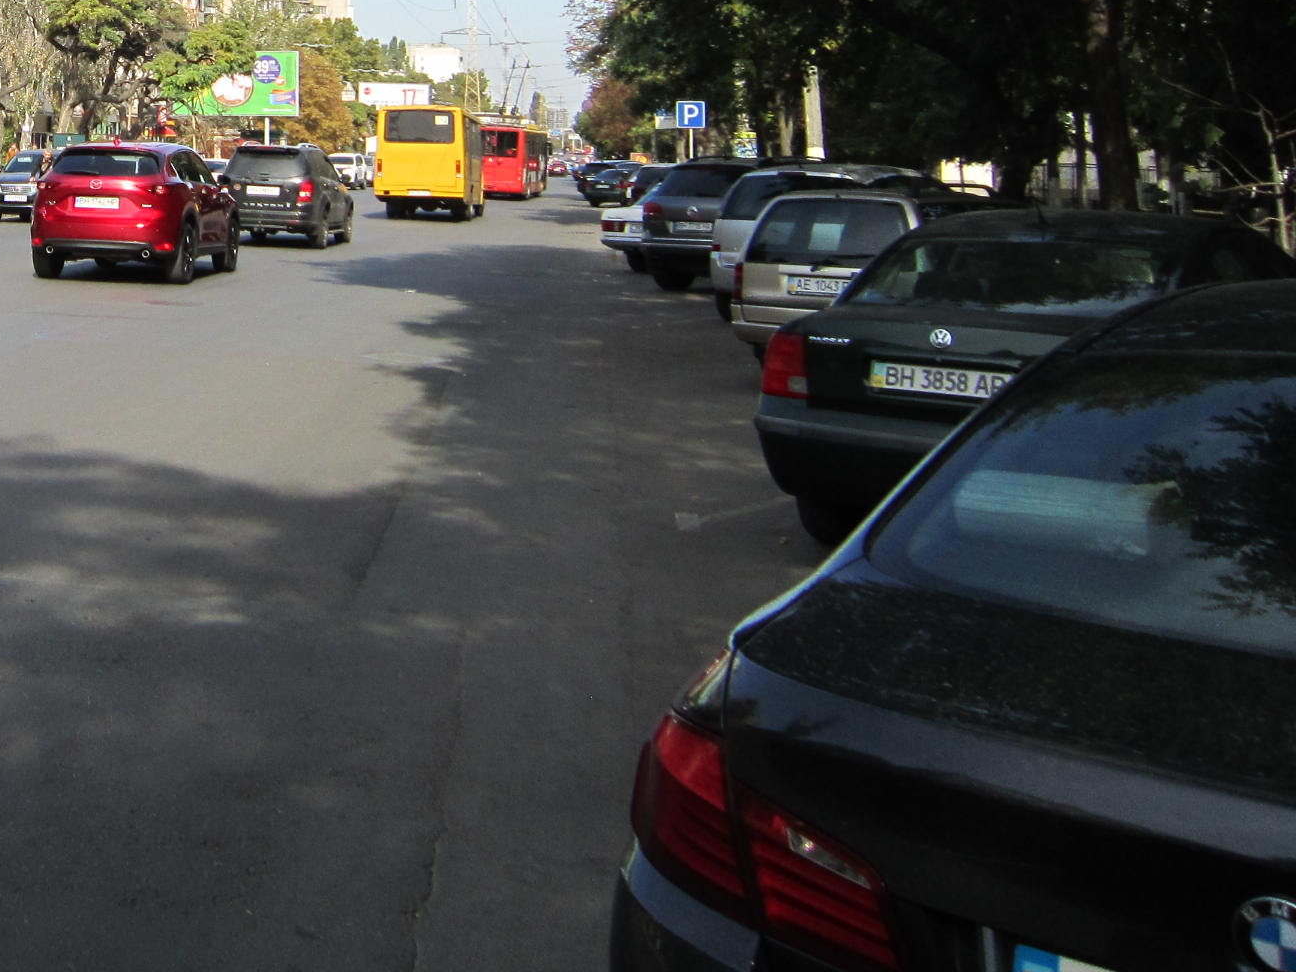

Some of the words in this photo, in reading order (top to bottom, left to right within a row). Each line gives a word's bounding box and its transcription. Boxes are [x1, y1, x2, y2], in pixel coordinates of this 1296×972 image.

[254, 60, 269, 74] 39
[684, 104, 699, 125] P
[797, 278, 811, 291] AE
[885, 366, 915, 388] BH
[920, 369, 969, 393] 3858
